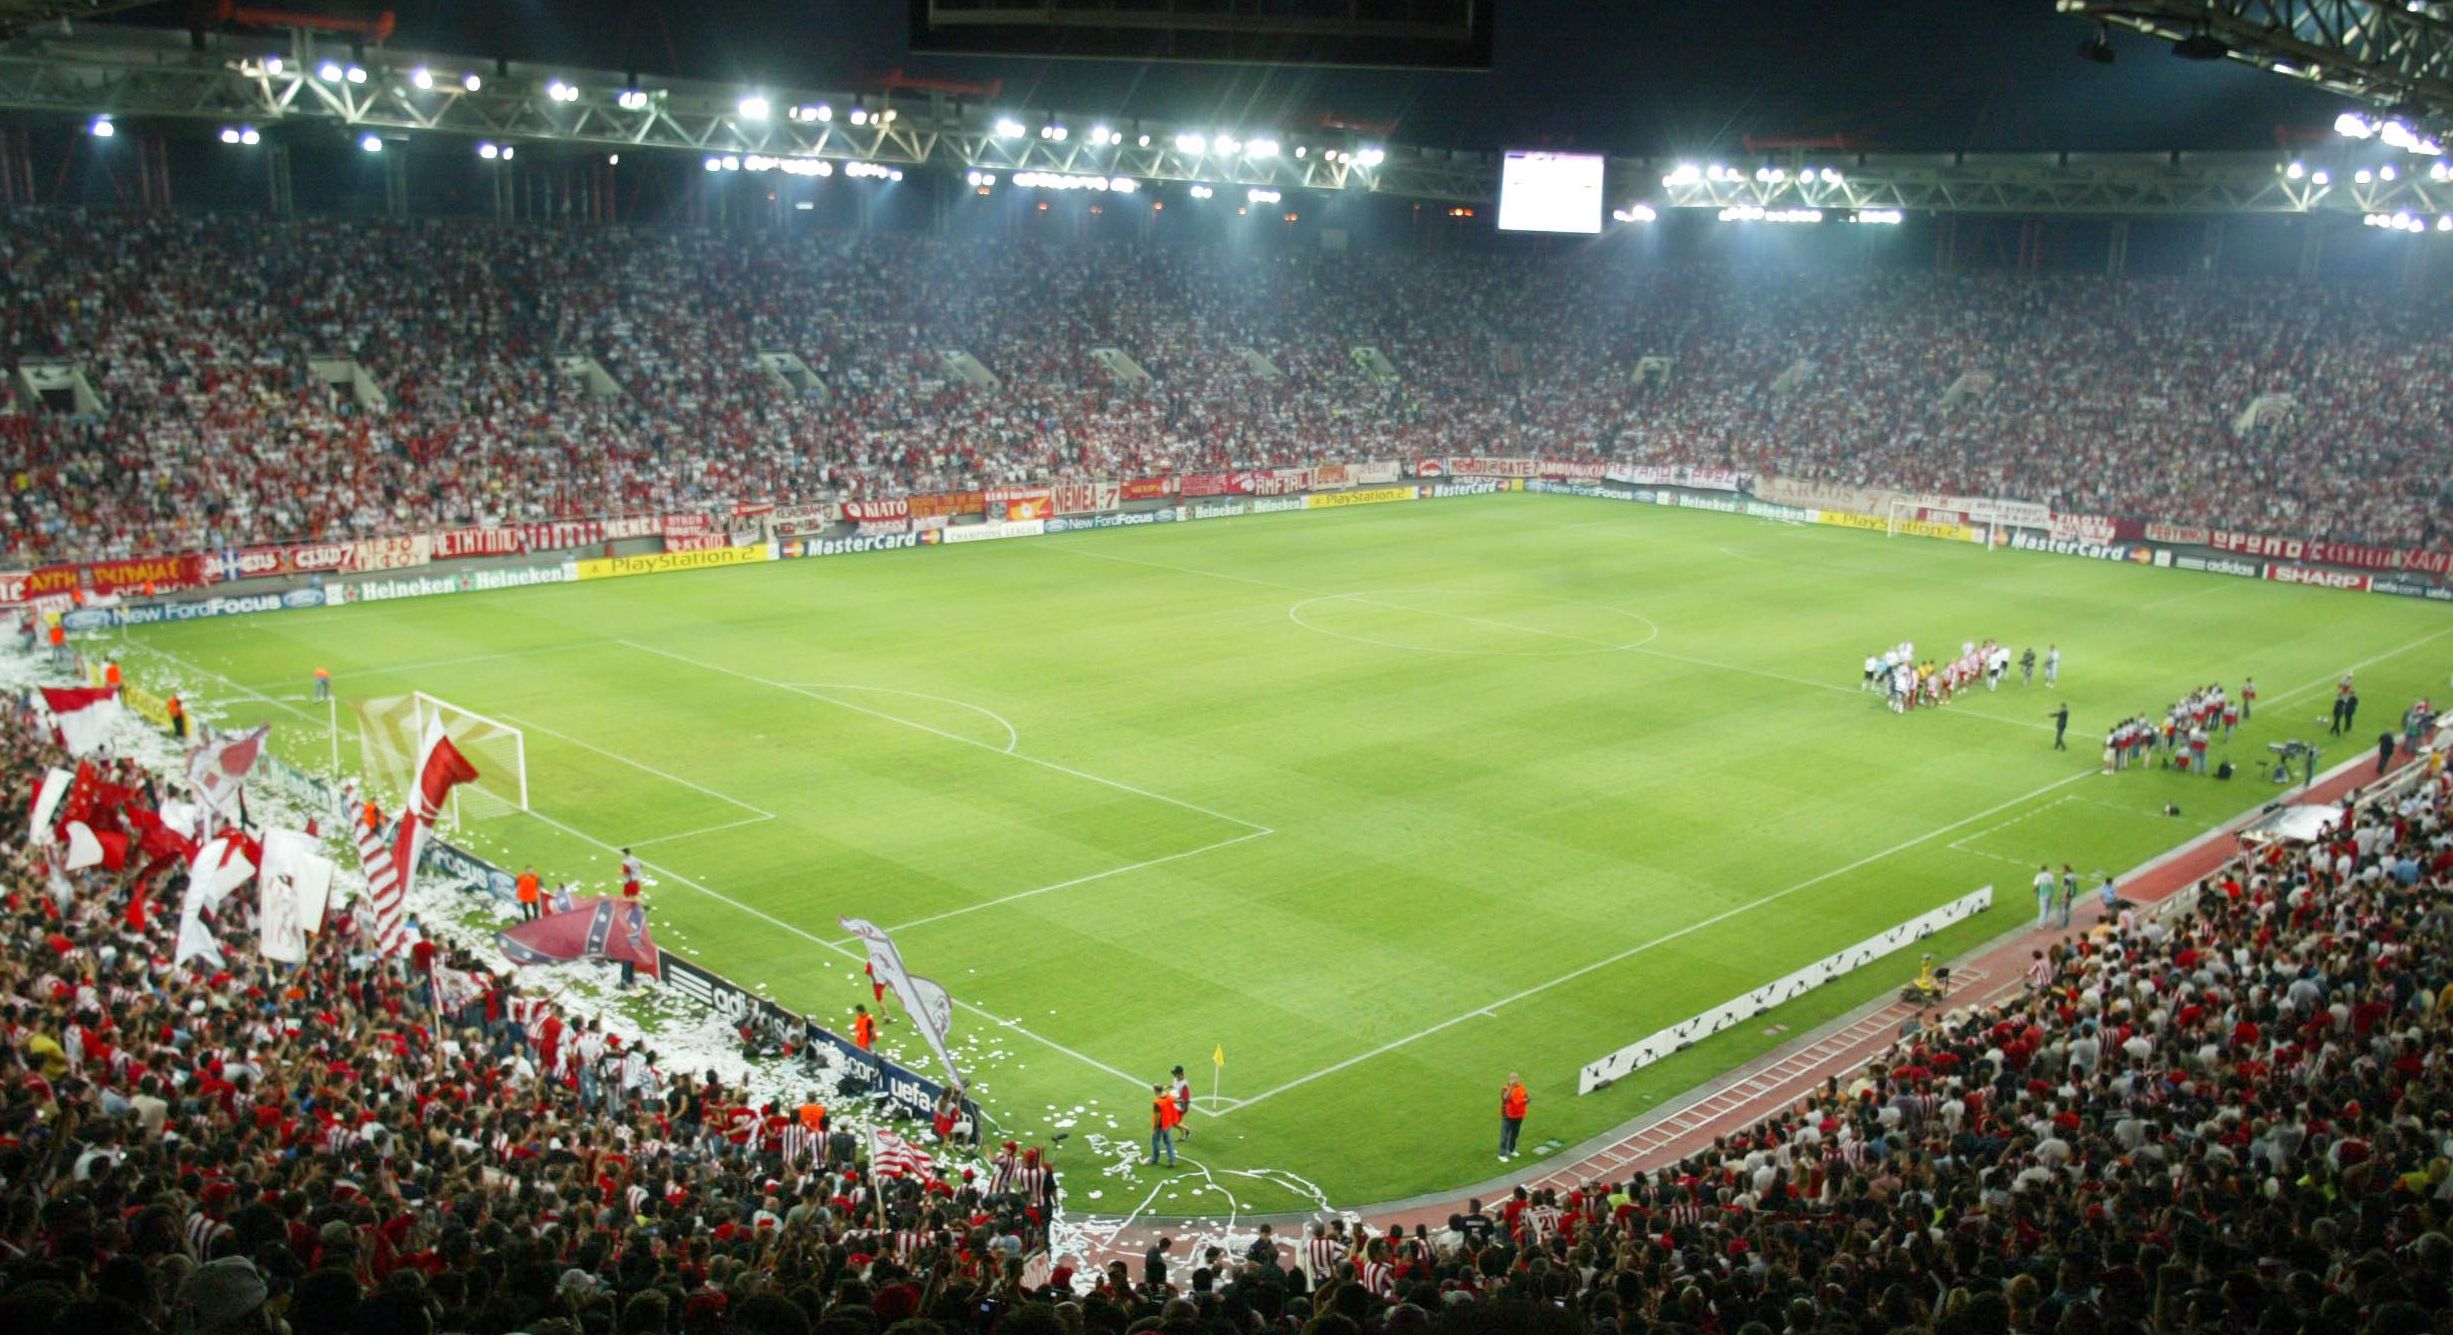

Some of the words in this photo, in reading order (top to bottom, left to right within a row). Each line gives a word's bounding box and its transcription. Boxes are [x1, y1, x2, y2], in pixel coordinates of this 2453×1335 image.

[1326, 489, 1394, 507] PlayStation
[1068, 517, 1094, 530] New
[808, 532, 918, 557] MasterCard
[2010, 532, 2125, 561] MasterCard
[611, 550, 734, 577] PlayStation
[741, 547, 755, 560] 2
[2207, 559, 2256, 576] adidas
[362, 577, 457, 602] Heineken
[477, 567, 563, 589] Heineken
[2275, 566, 2362, 590] SHARP
[112, 605, 163, 625] New
